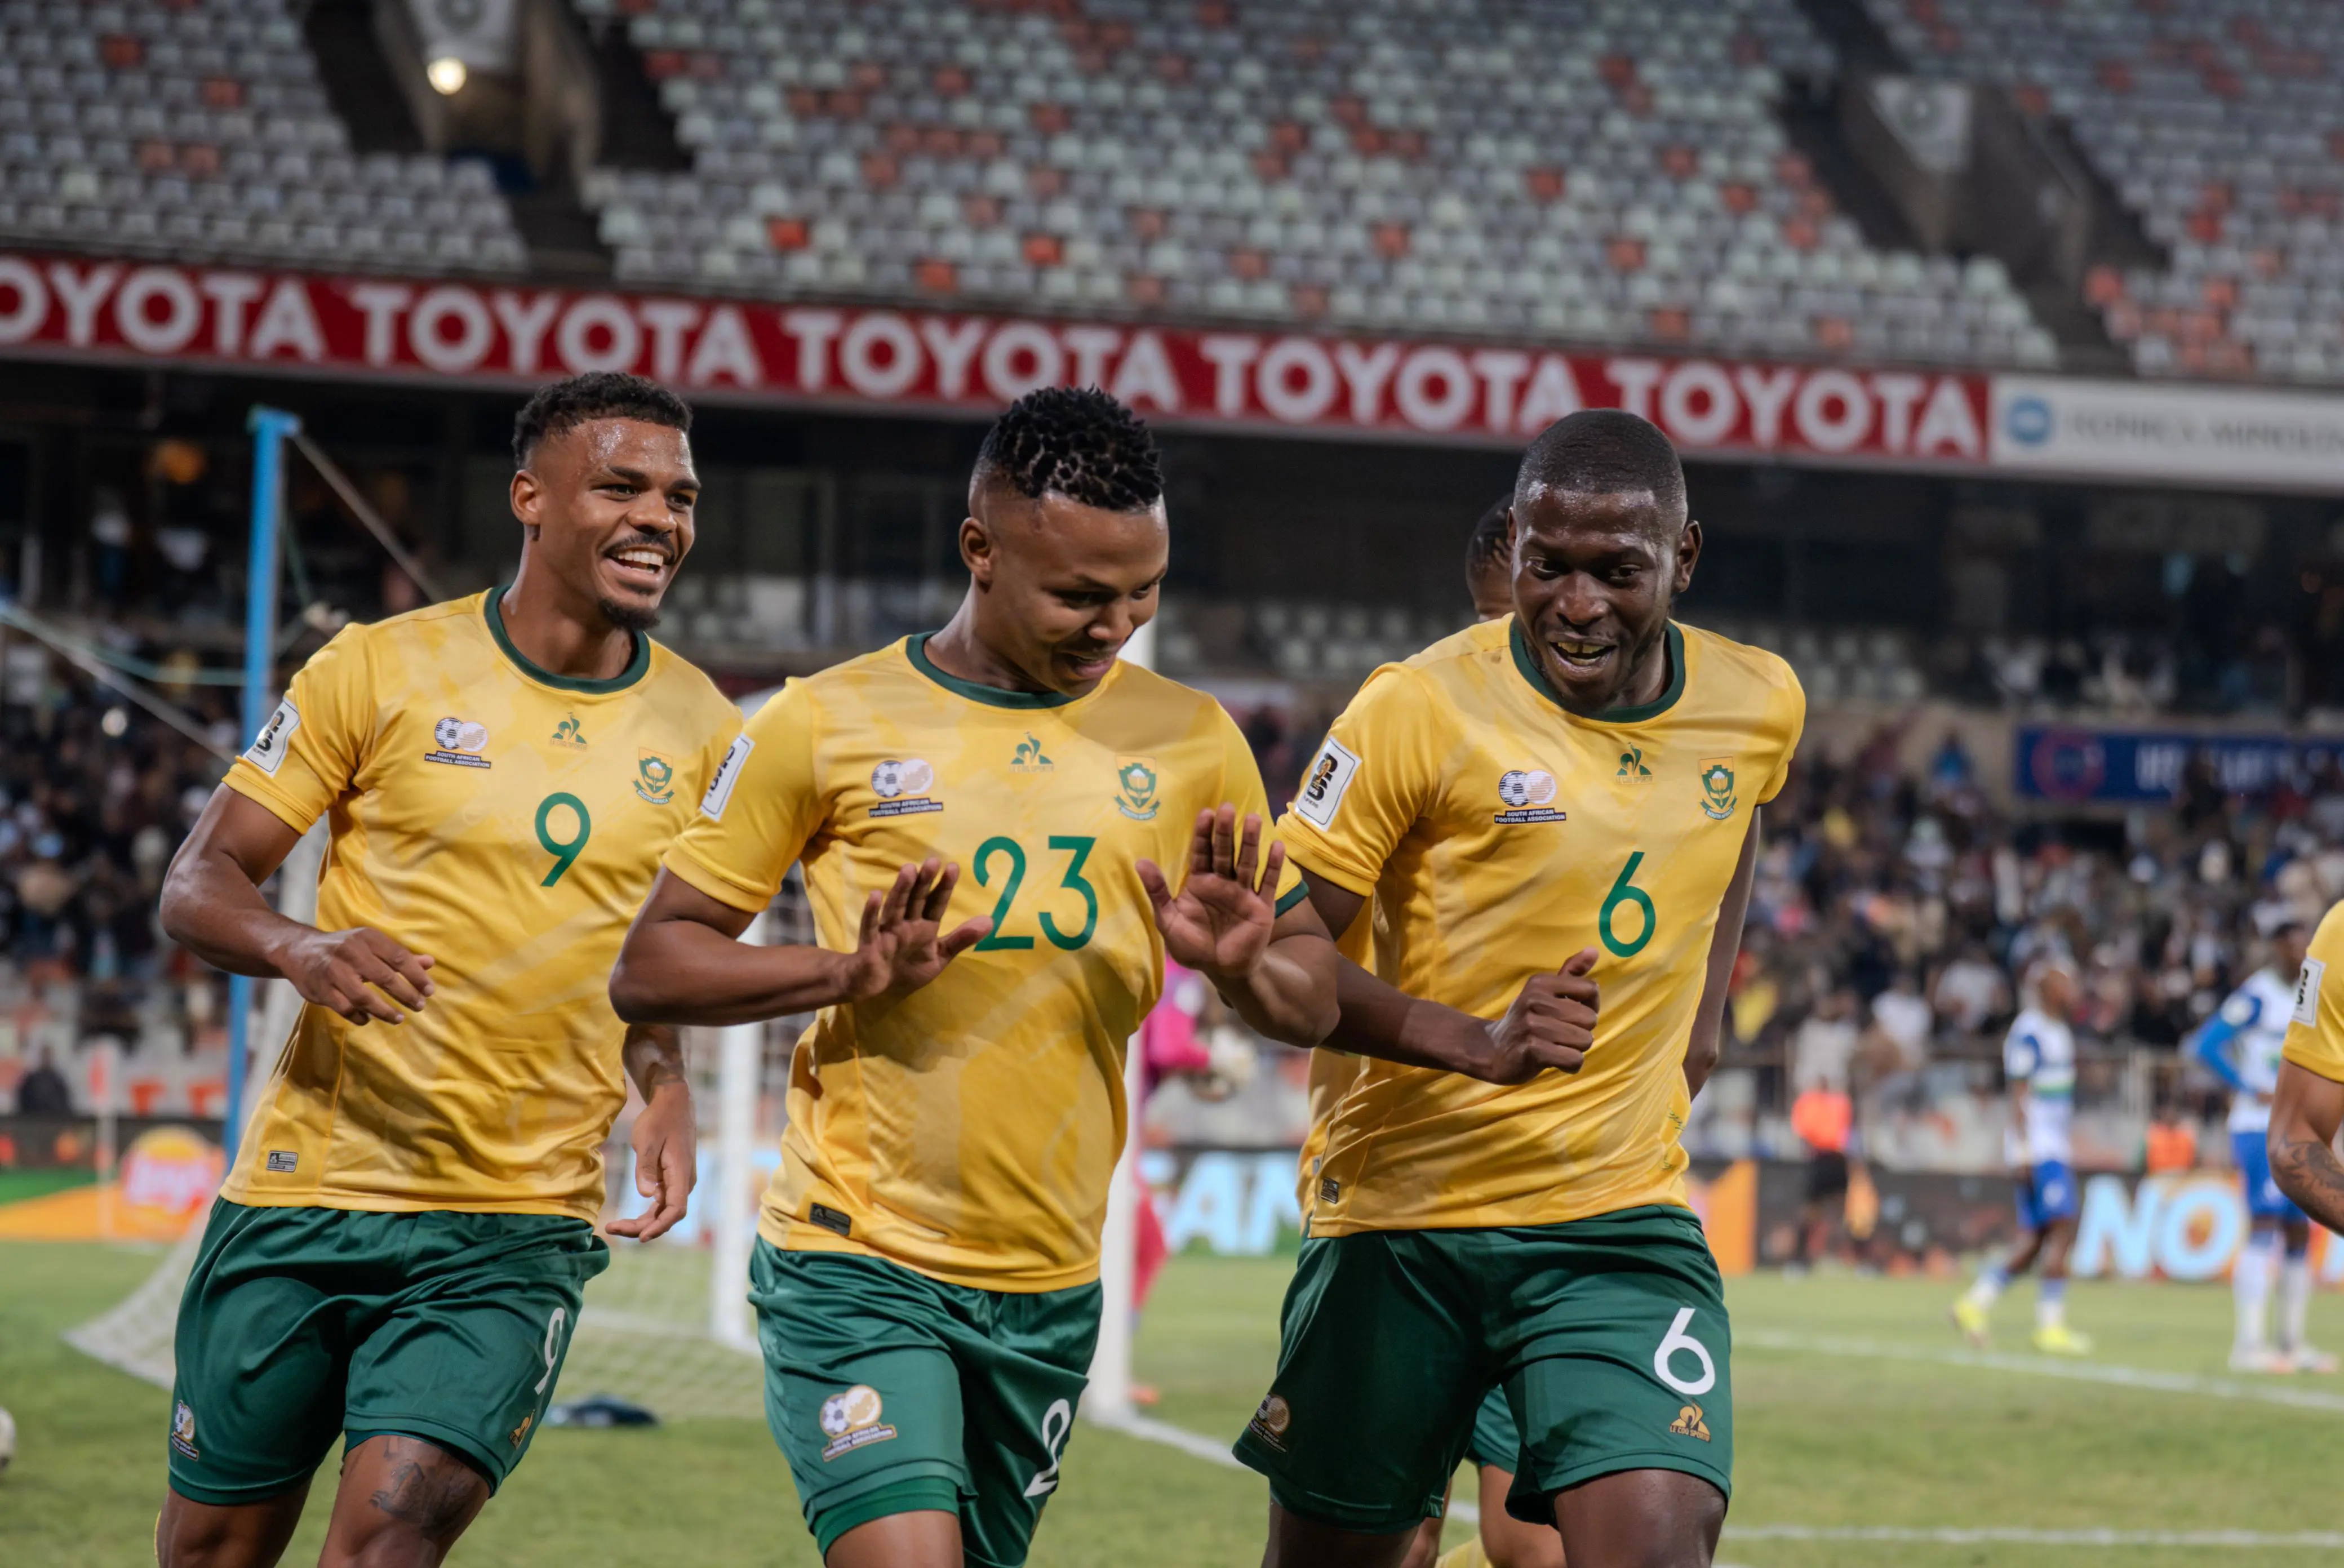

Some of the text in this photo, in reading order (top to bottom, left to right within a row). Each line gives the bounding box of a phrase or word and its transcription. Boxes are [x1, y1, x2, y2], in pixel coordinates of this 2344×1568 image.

[348, 282, 760, 389] TOYOTA
[781, 309, 1179, 412] TOYOTA
[1199, 334, 1579, 435] TOYOTA
[1605, 358, 1980, 455] TOYOTA
[534, 792, 591, 887] 9
[973, 836, 1098, 952] 23
[1599, 851, 1657, 958] 6
[534, 1307, 565, 1396] 9
[1654, 1307, 1716, 1396] 6
